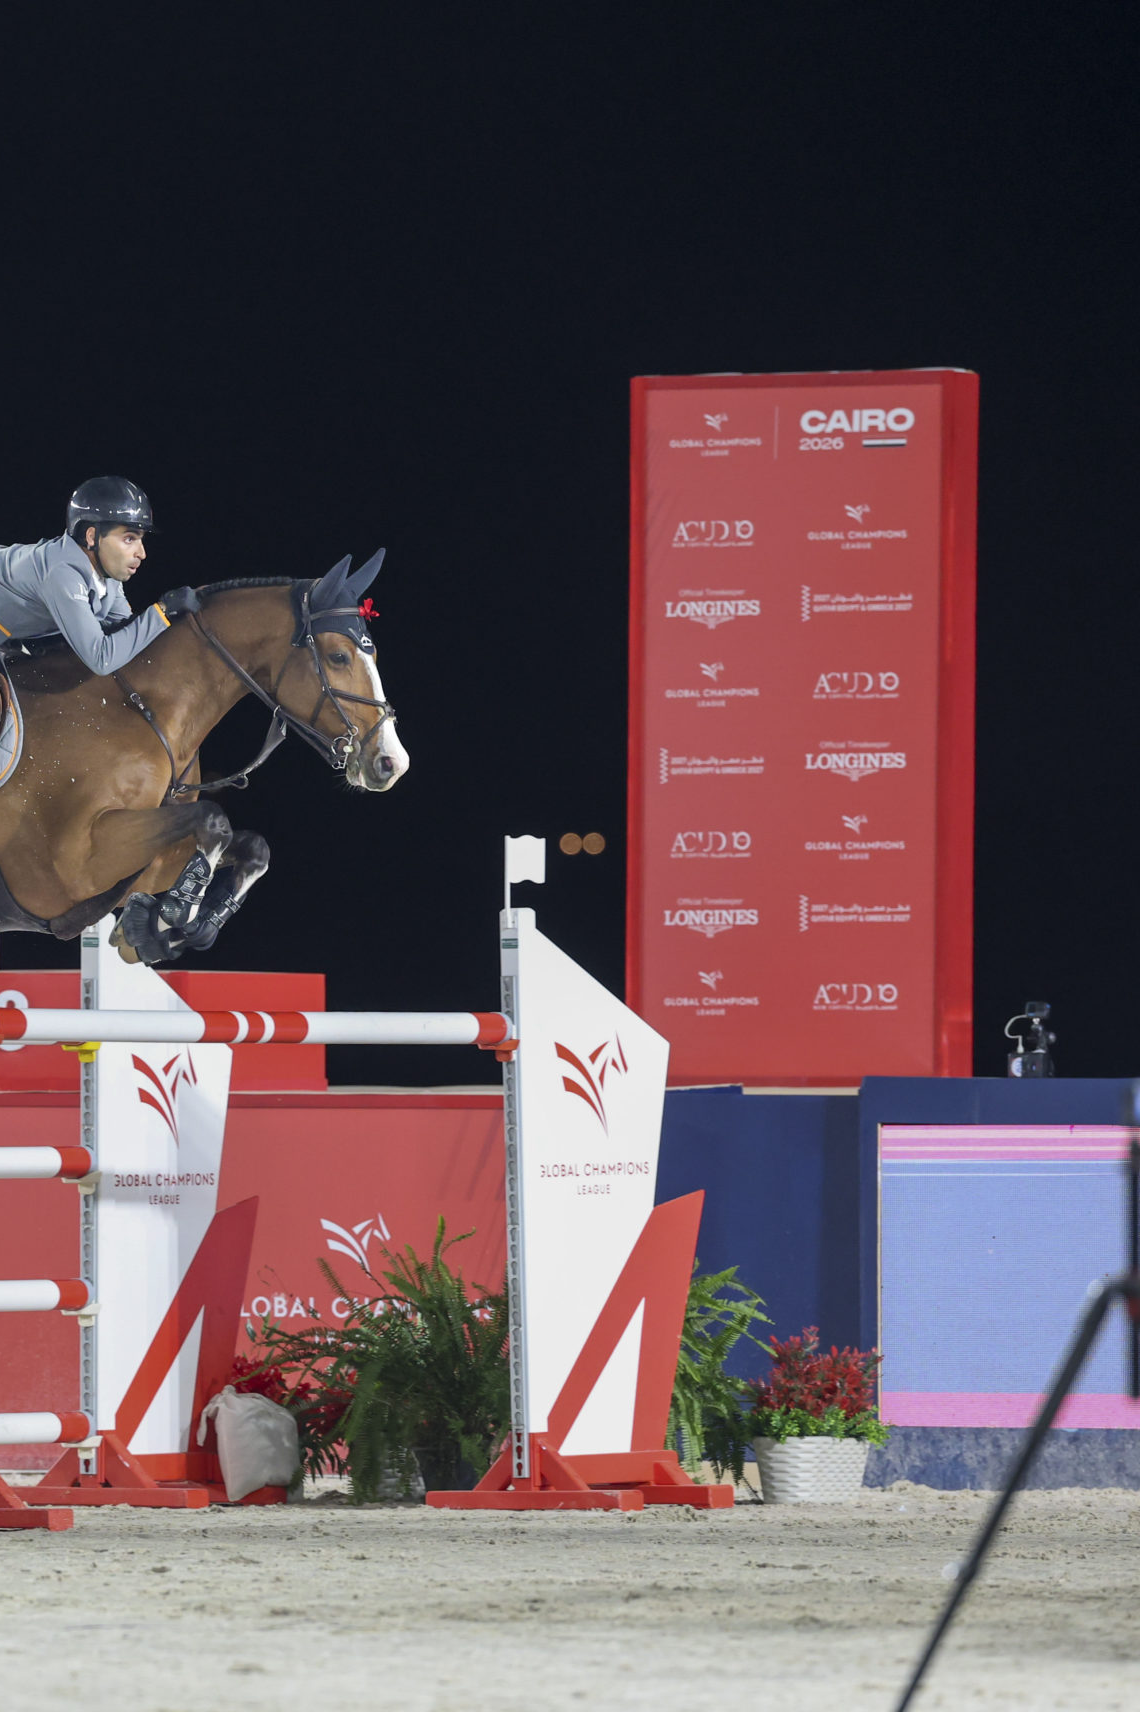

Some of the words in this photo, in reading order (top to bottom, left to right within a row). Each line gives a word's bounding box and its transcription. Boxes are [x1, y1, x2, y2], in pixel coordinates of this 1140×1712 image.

[800, 408, 915, 434] CAIRO
[799, 436, 845, 451] 2026
[807, 531, 845, 541] GLOBAL
[847, 530, 907, 540] CHAMPIONS
[666, 599, 760, 617] LONGINES
[665, 688, 701, 698] GLOBAL
[703, 687, 759, 697] CHAMPIONS
[805, 752, 906, 770] LONGINES
[805, 841, 842, 851] GLOBAL
[845, 840, 905, 850] CHAMPIONS
[664, 909, 758, 926] LONGINES
[664, 997, 699, 1006] GLOBAL
[702, 996, 759, 1006] CHAMPIONS
[583, 1160, 650, 1177] CHAMPIONS
[155, 1172, 215, 1187] CHAMPIONS
[577, 1183, 611, 1196] LEAGUE
[148, 1194, 181, 1205] LEAGUE
[239, 1296, 321, 1318] LOBAL
